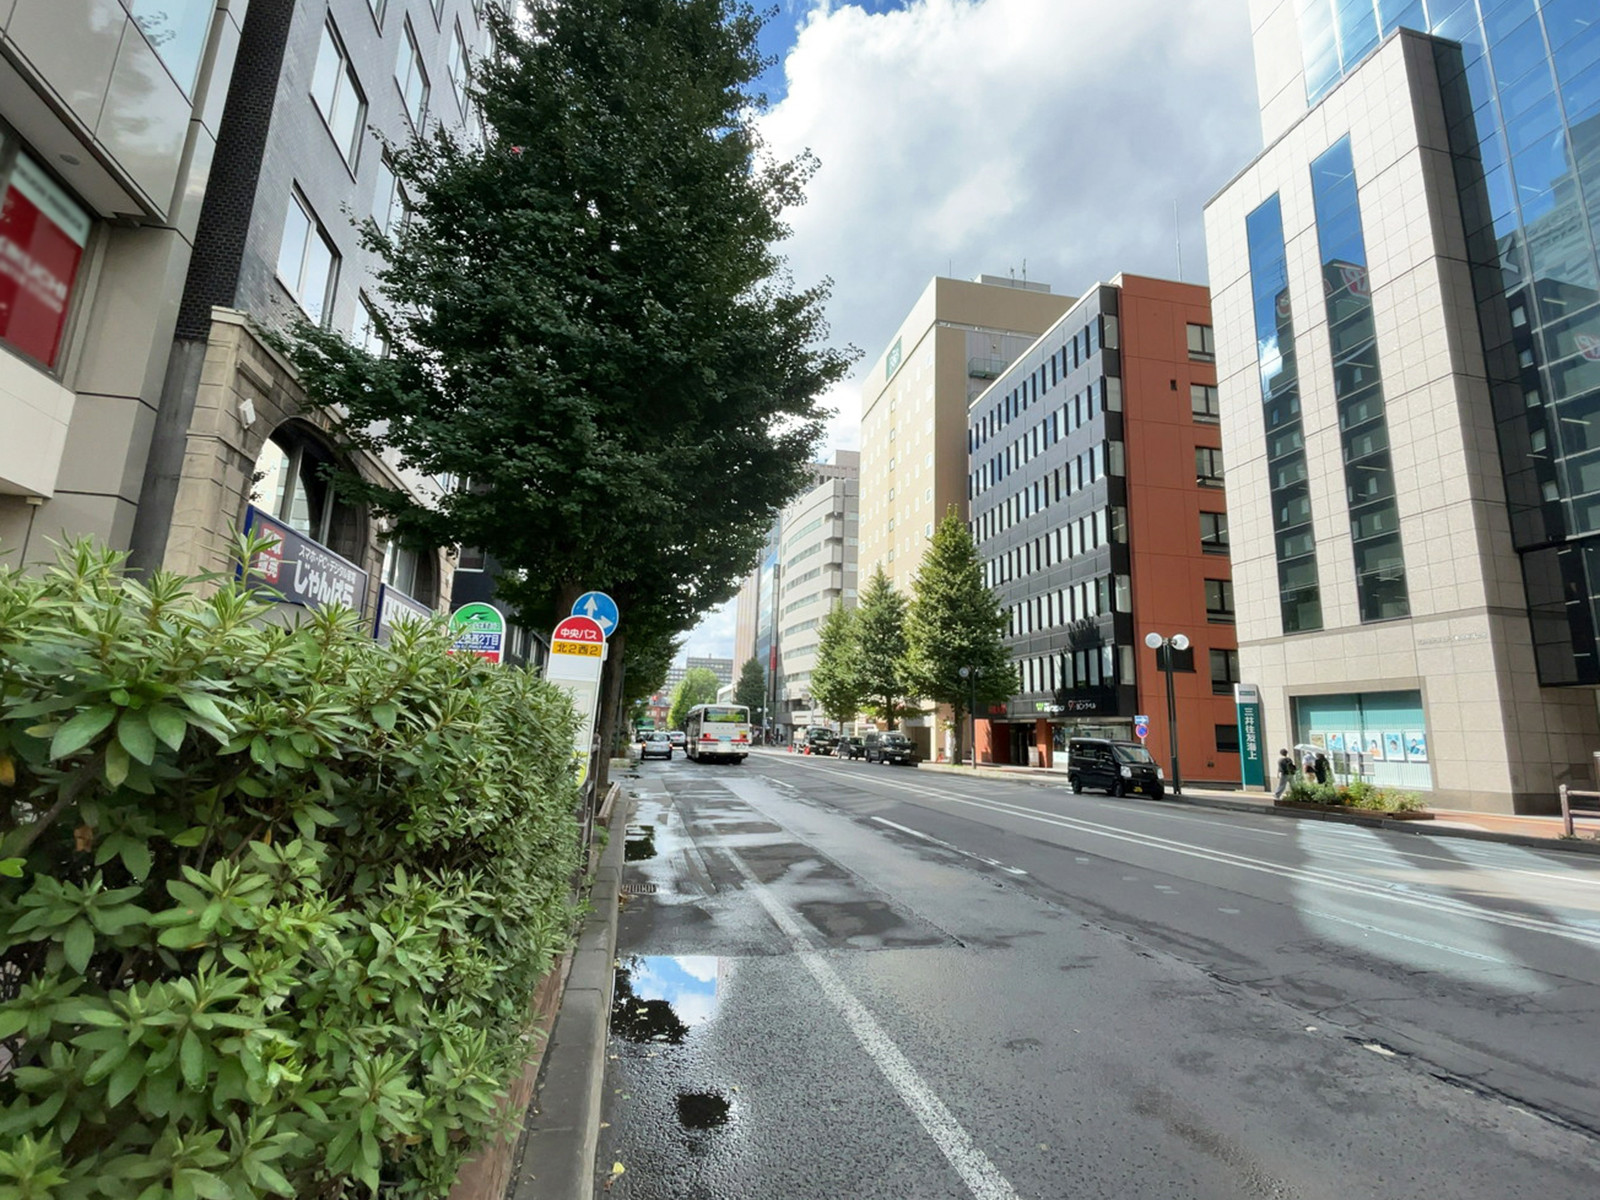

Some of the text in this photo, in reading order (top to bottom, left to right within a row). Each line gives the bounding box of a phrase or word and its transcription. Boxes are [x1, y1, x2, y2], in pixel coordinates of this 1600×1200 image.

[560, 627, 598, 640] 中央バス
[557, 642, 599, 656] 北2西2
